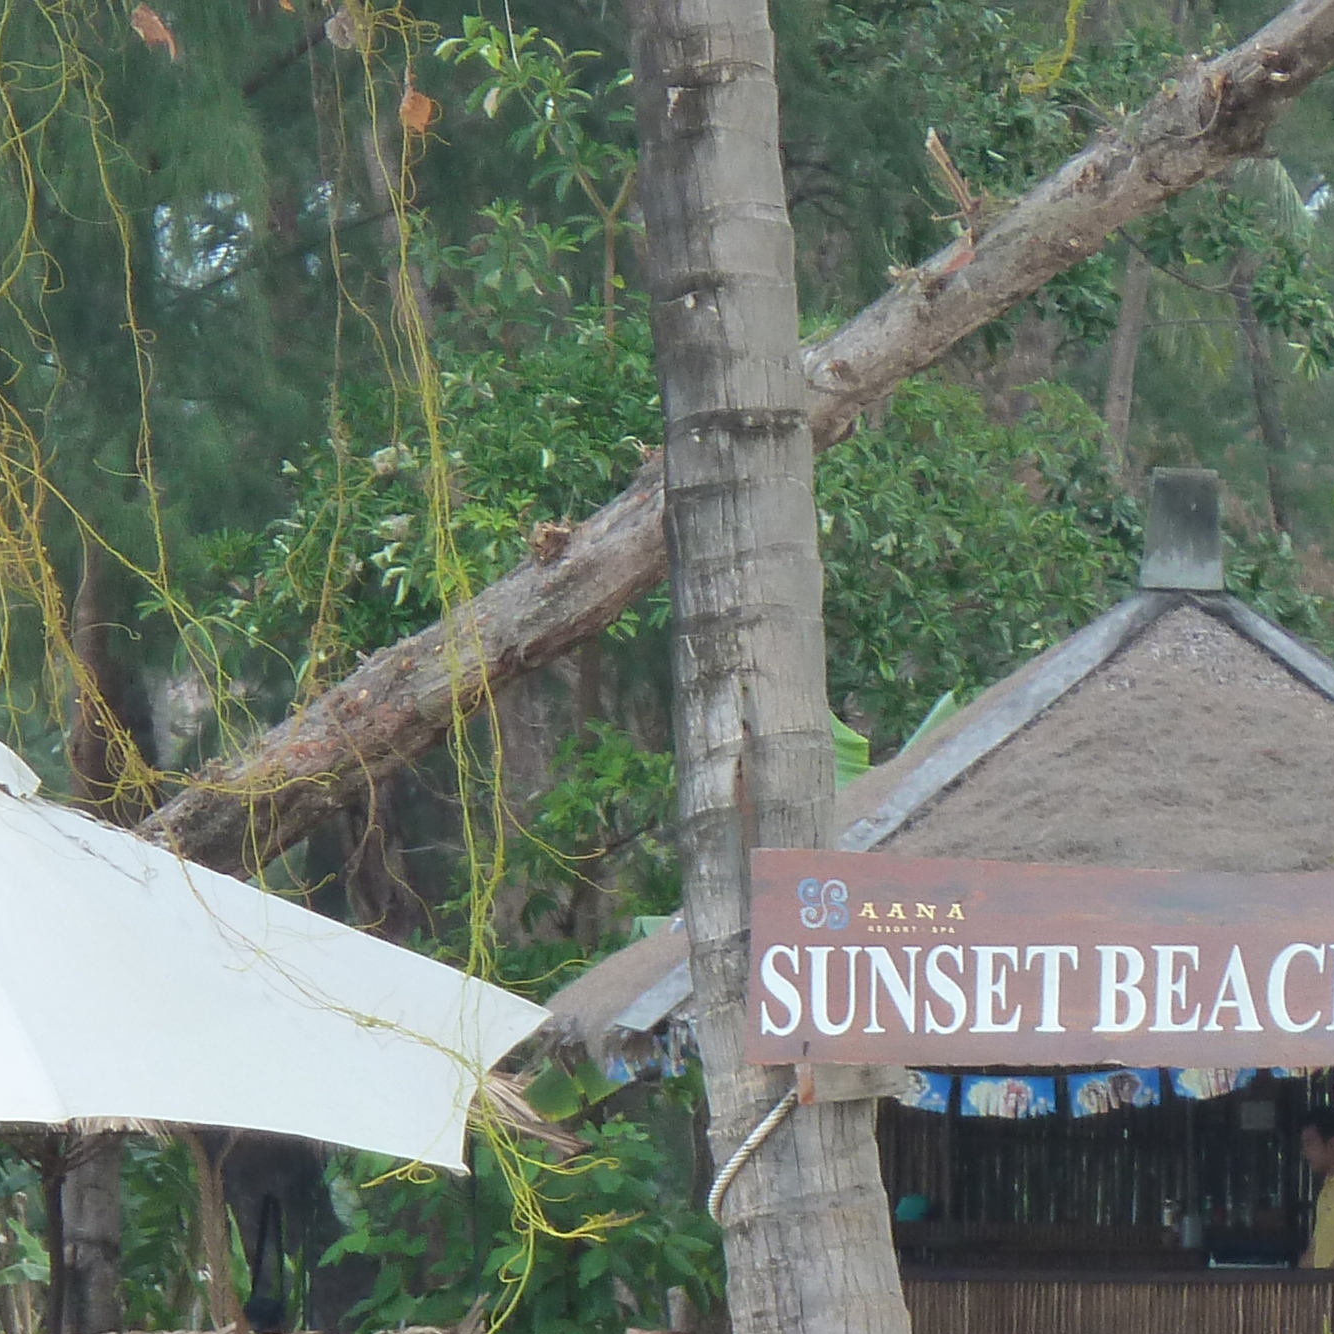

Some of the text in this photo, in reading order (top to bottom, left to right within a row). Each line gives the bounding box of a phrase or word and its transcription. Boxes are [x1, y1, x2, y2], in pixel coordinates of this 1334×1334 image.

[858, 902, 965, 920] AANA
[867, 925, 955, 934] RESORT SPA
[760, 944, 1079, 1036] SUNSET
